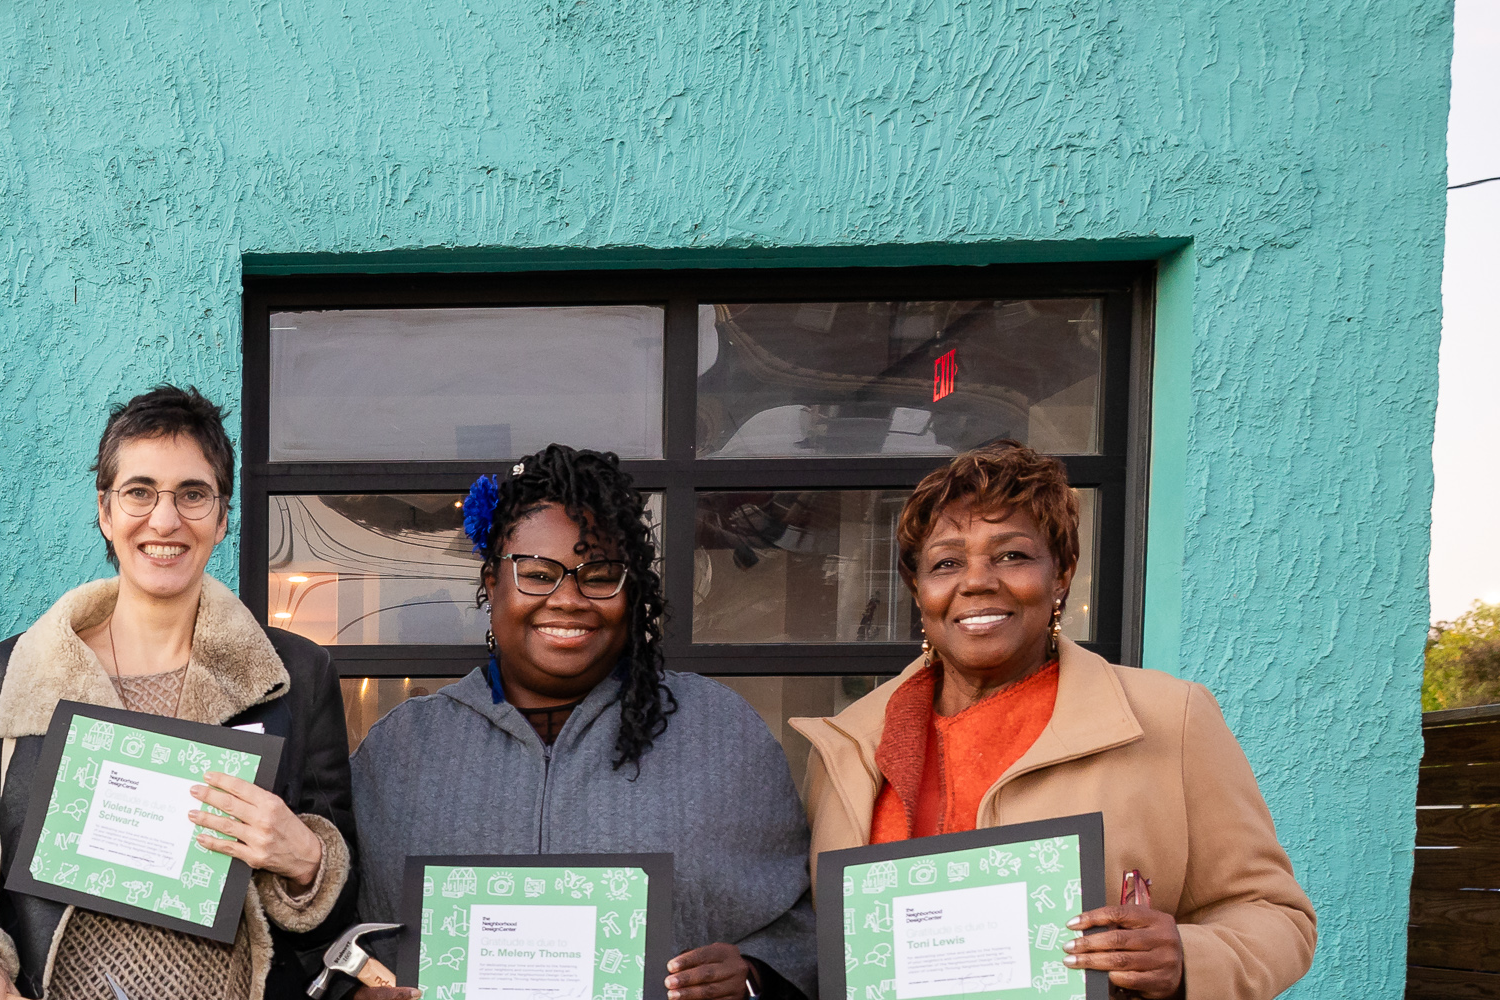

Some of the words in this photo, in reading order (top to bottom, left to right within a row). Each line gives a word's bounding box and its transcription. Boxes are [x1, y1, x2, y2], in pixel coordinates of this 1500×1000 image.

[933, 349, 956, 402] EXIT
[98, 810, 140, 828] Schwartz
[102, 800, 132, 814] Violeta
[133, 807, 164, 822] Fiorino
[906, 938, 930, 949] Toni
[932, 936, 965, 947] Lewis
[480, 948, 495, 957] Dr.
[497, 949, 536, 959] Meleny
[538, 949, 582, 958] Thomas
